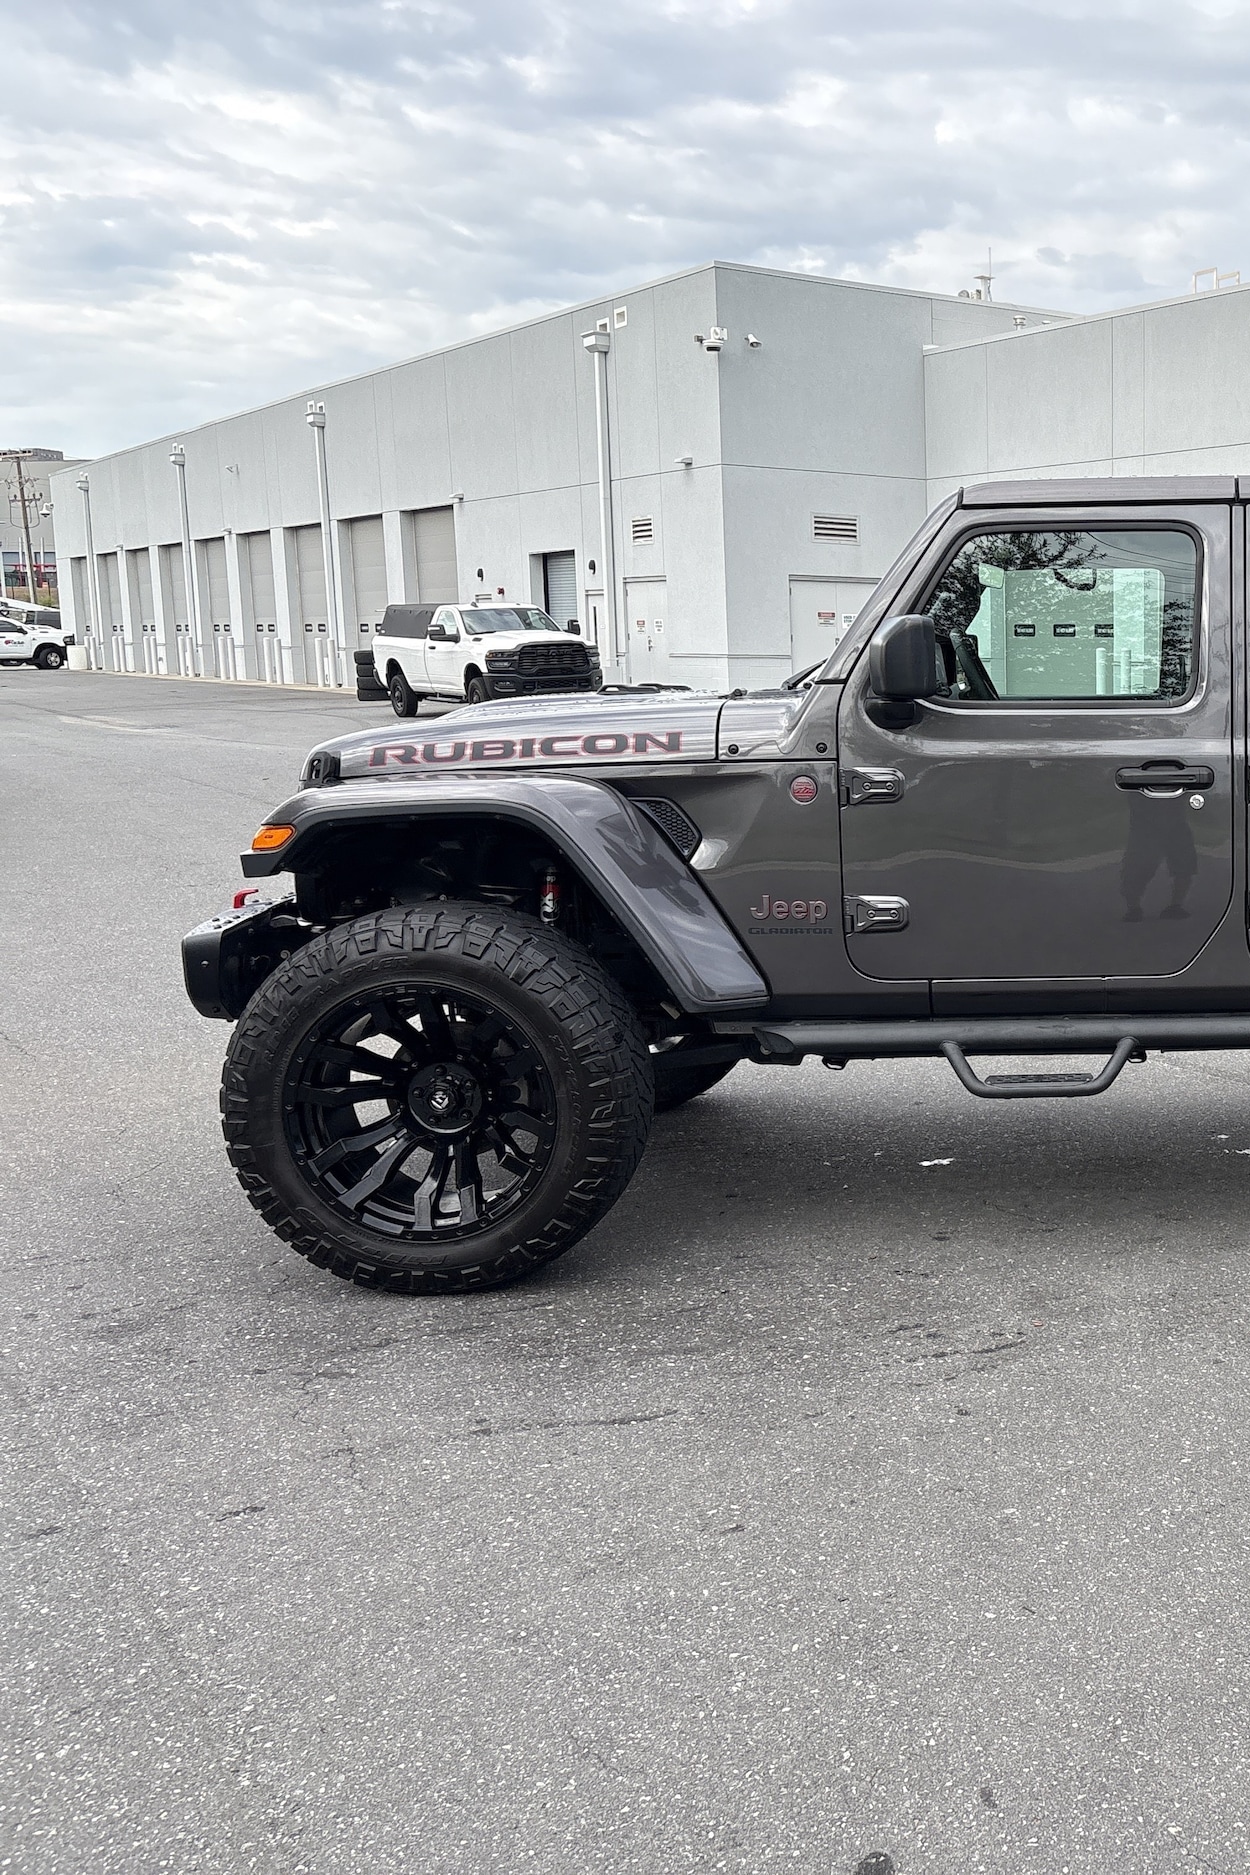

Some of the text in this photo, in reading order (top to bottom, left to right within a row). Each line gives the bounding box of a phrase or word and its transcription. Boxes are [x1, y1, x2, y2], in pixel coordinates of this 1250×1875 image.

[369, 731, 683, 767] RUBICON
[750, 894, 828, 924] Jeep
[748, 927, 833, 935] GLADIATOR
